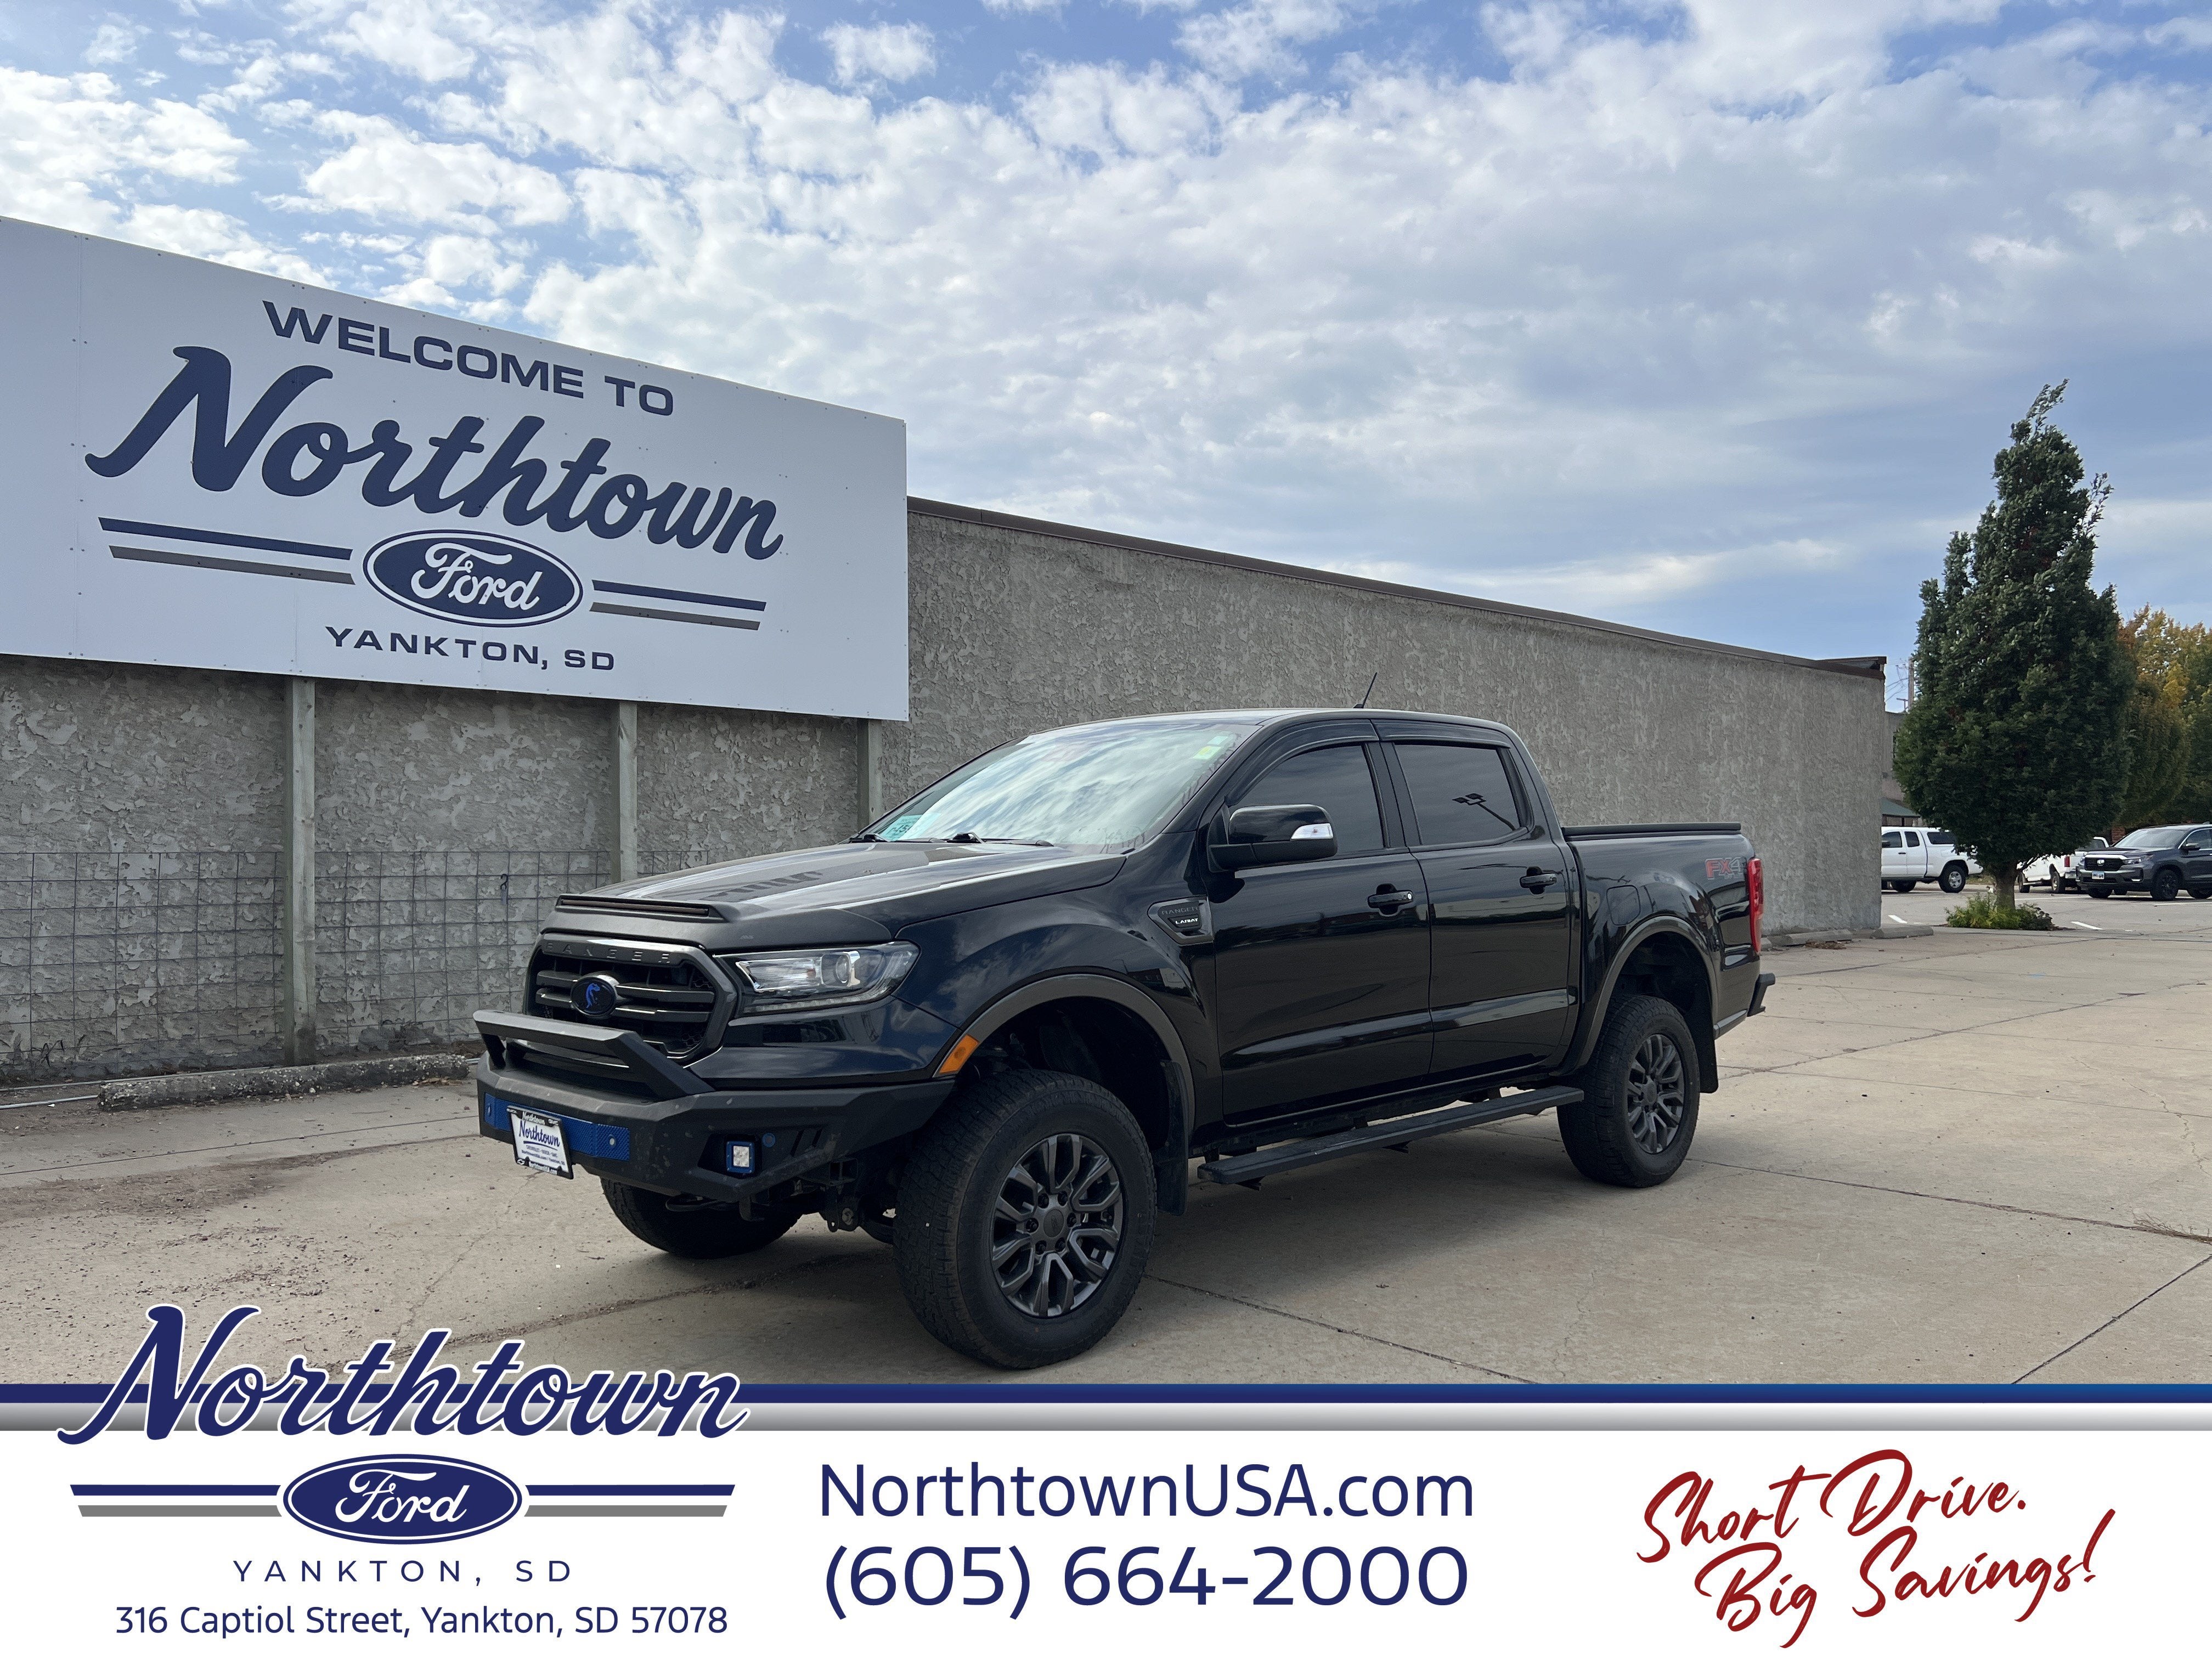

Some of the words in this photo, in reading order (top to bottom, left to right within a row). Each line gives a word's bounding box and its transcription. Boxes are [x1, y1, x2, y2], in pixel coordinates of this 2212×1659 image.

[261, 299, 584, 399] WELCOME
[604, 375, 674, 417] TO
[84, 345, 785, 561] Northtown
[410, 541, 544, 611] Ford
[325, 626, 548, 671] YANKTON,
[564, 649, 615, 671] SD
[1705, 857, 1743, 880] FX4
[518, 1120, 561, 1147] Northtown
